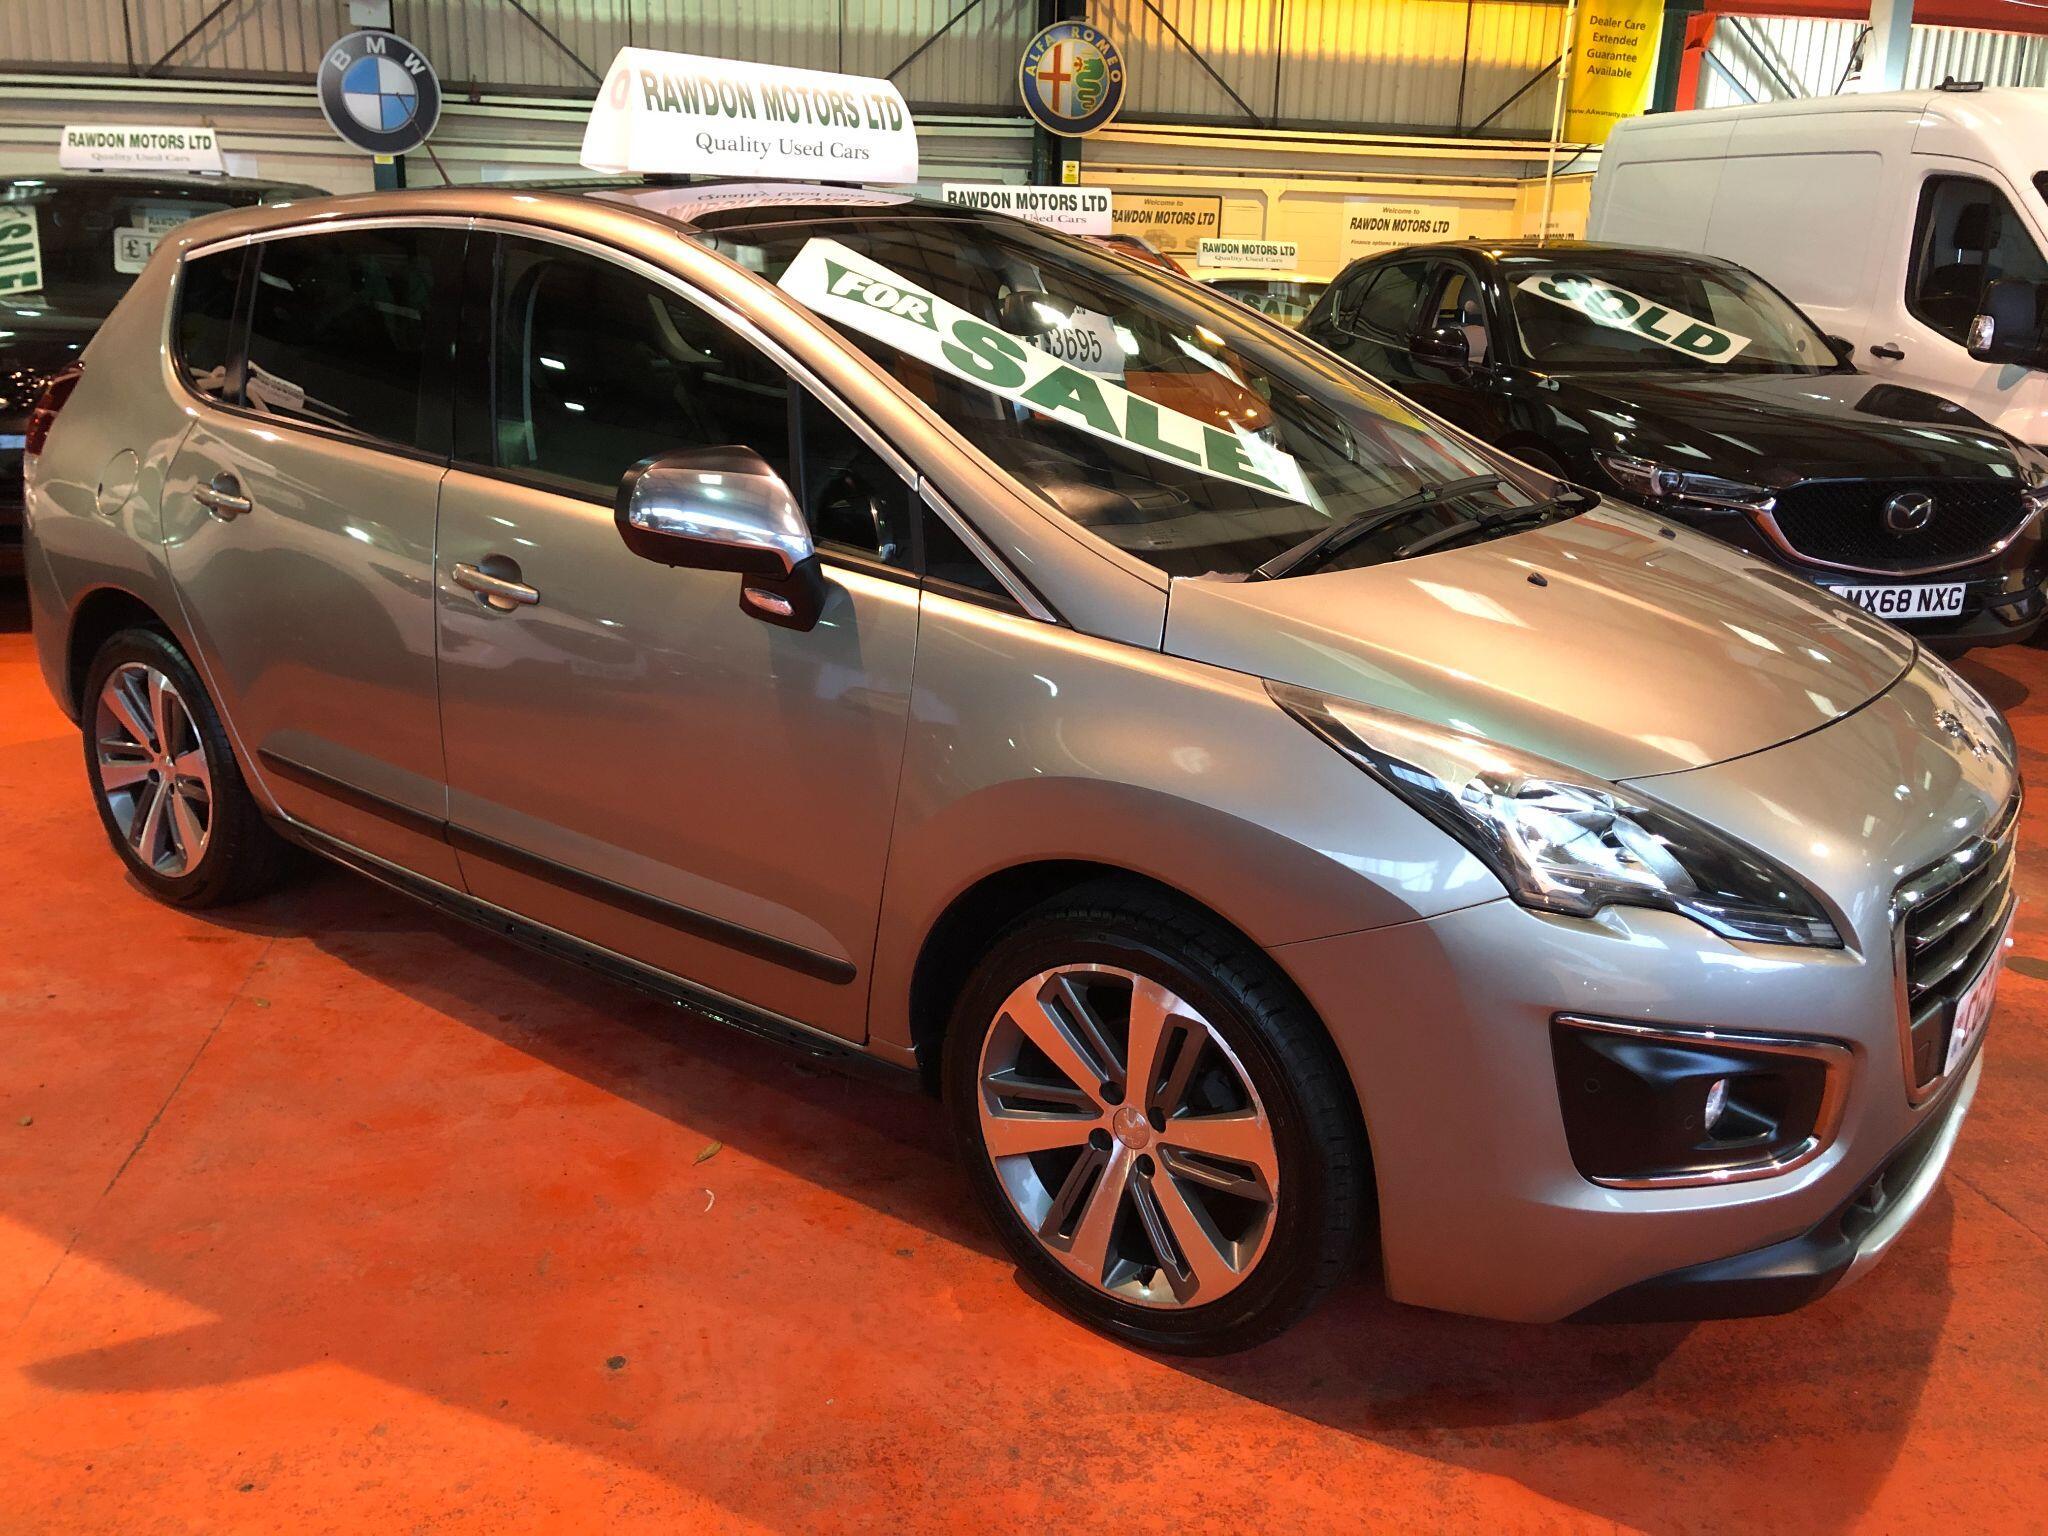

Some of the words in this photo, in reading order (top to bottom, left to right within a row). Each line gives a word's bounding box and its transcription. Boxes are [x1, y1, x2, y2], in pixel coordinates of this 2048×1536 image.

[1589, 15, 1622, 28] Dealer
[1624, 19, 1646, 30] Care
[1593, 32, 1638, 46] Extended
[330, 36, 426, 75] BMW
[1025, 33, 1057, 77] ALFA
[1071, 26, 1121, 83] ROMEO
[1587, 48, 1637, 62] Guarantee
[1587, 65, 1632, 78] Available
[639, 68, 757, 120] RAWDON
[760, 82, 860, 129] MOTORS
[862, 94, 903, 132] LTD
[68, 132, 125, 148] RAWDON
[129, 134, 185, 150] MOTORS
[189, 135, 212, 150] LTD
[695, 131, 772, 159] Quality
[779, 138, 823, 157] Used
[830, 142, 870, 160] Cars
[91, 153, 132, 162] Quality
[947, 190, 1011, 209] RAWDON
[1016, 193, 1078, 211] MOTORS
[1082, 195, 1108, 212] LTD
[1144, 198, 1175, 207] Welcome
[1023, 213, 1054, 223] Used
[1058, 214, 1087, 223] Cars
[1112, 209, 1153, 224] RAWDON
[1154, 211, 1196, 225] MOTORS
[1197, 213, 1215, 226] LTD
[1382, 207, 1412, 215] Welcome
[1350, 217, 1390, 231] RAWDON
[1392, 219, 1431, 233] MOTORS
[1432, 221, 1450, 234] LTD
[1202, 242, 1240, 254] RAWDON
[1241, 244, 1278, 255] MOTORS
[1280, 246, 1296, 257] LTD
[831, 270, 931, 323] FOR
[1538, 272, 1731, 356] SOLD
[941, 319, 1290, 494] SALE
[1847, 589, 1912, 613] MX68
[1917, 587, 1962, 612] NXG
